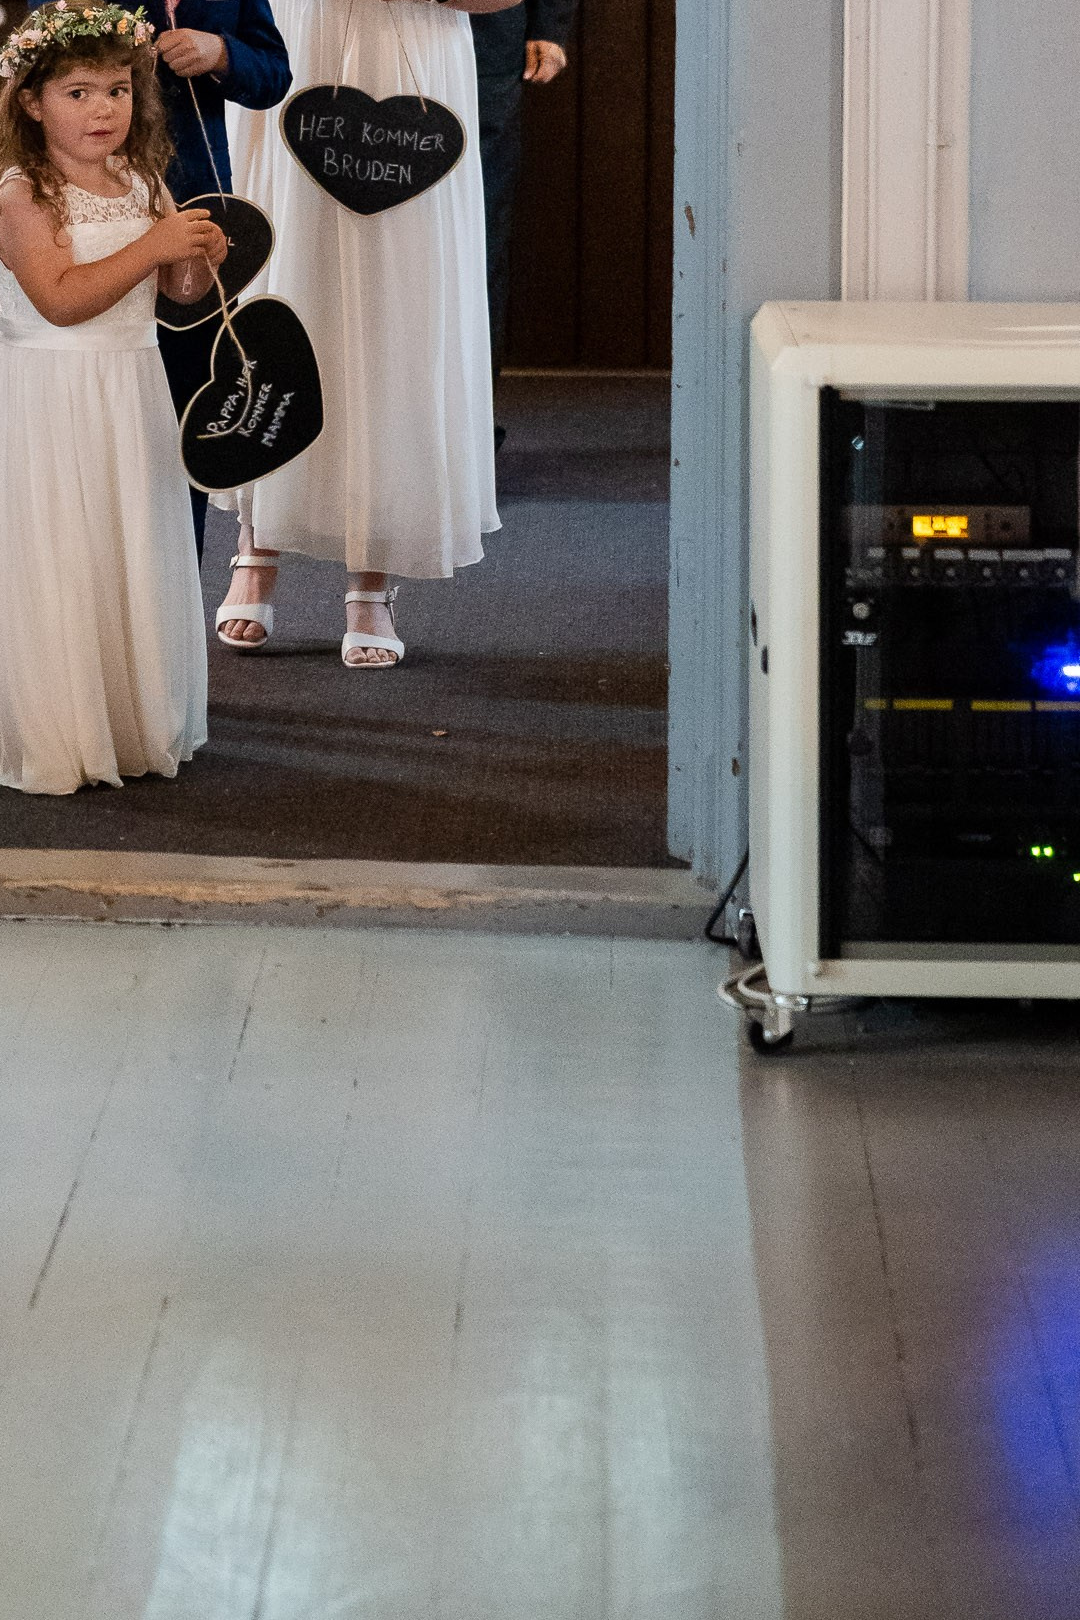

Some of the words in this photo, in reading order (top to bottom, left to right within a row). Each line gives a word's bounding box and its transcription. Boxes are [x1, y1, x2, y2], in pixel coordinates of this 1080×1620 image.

[299, 114, 345, 141] HER
[361, 121, 446, 153] KOMMER
[323, 147, 413, 185] BRUDEN
[237, 382, 273, 438] KOMMER
[260, 391, 296, 448] MAMMA
